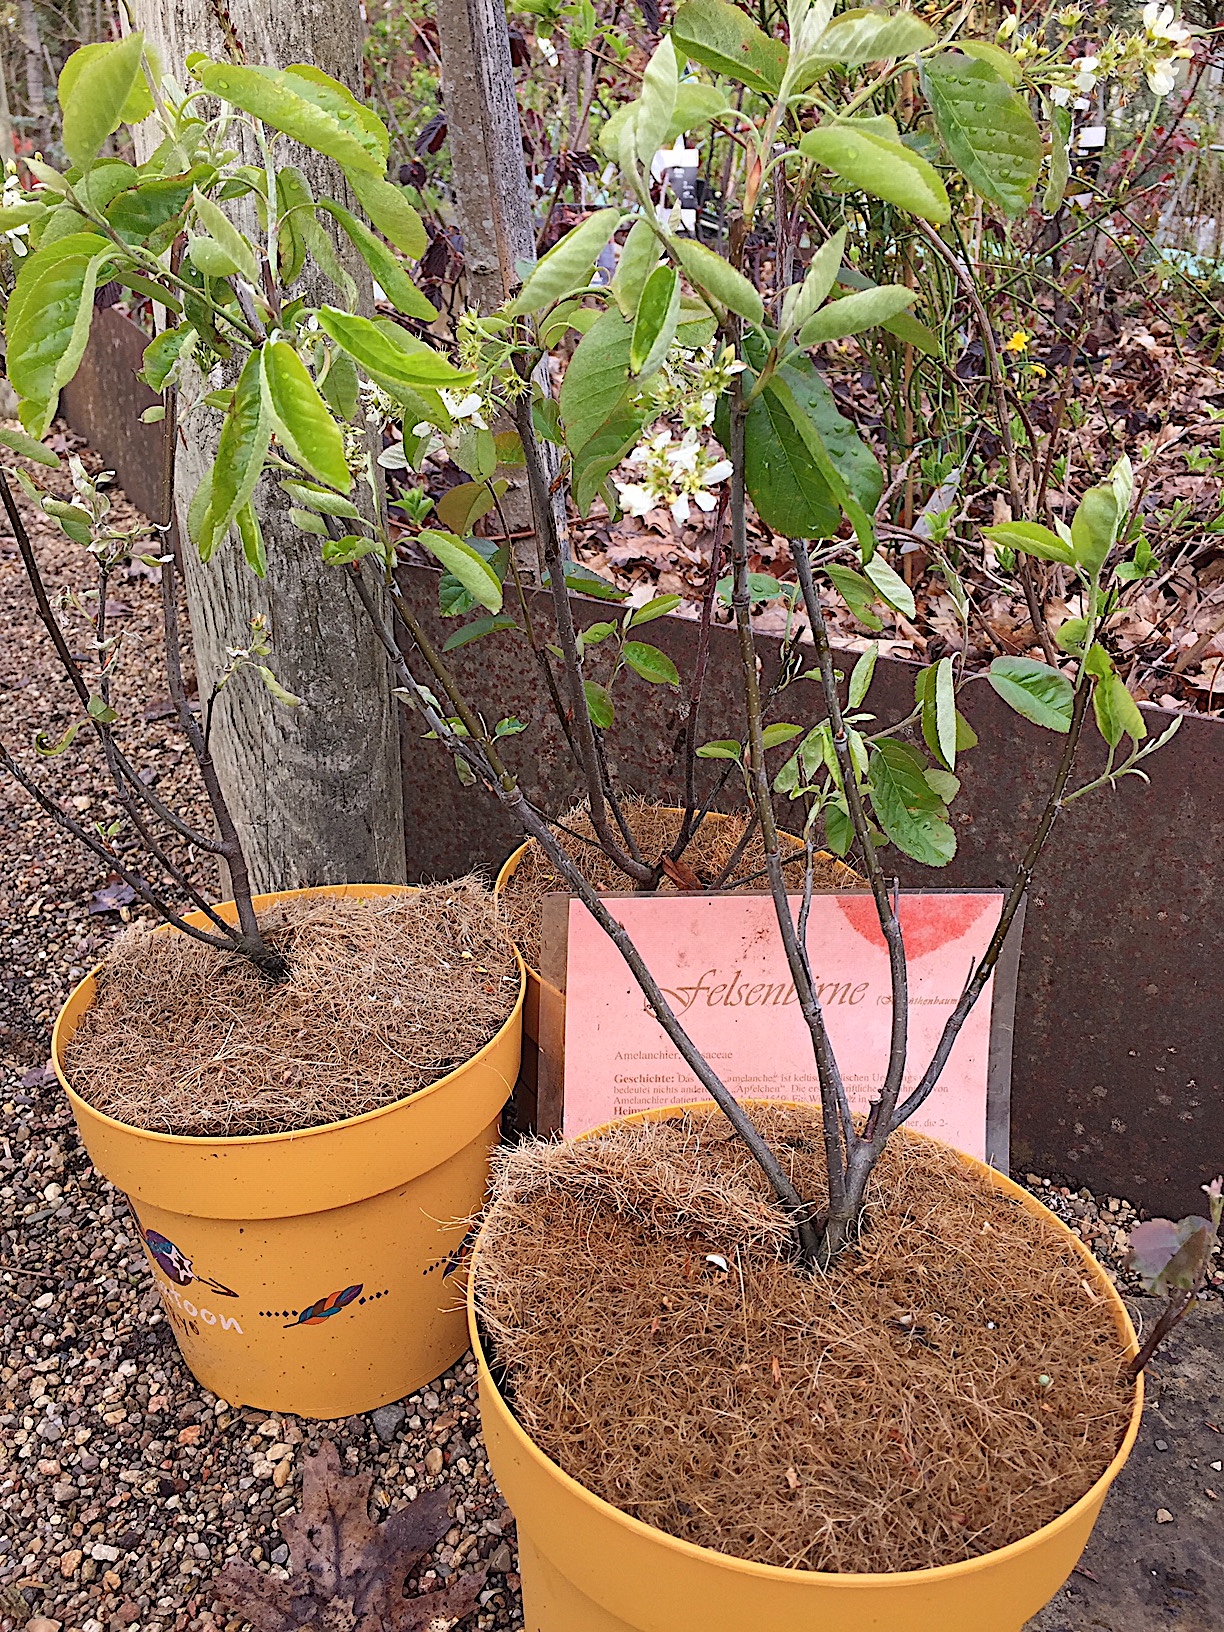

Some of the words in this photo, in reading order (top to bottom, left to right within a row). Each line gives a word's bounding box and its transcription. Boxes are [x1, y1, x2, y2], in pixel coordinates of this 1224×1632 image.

[614, 1073, 674, 1084] Geschichte:
[678, 1074, 694, 1083] Das
[653, 1085, 678, 1094] nichts
[613, 1096, 668, 1105] Amelanchier
